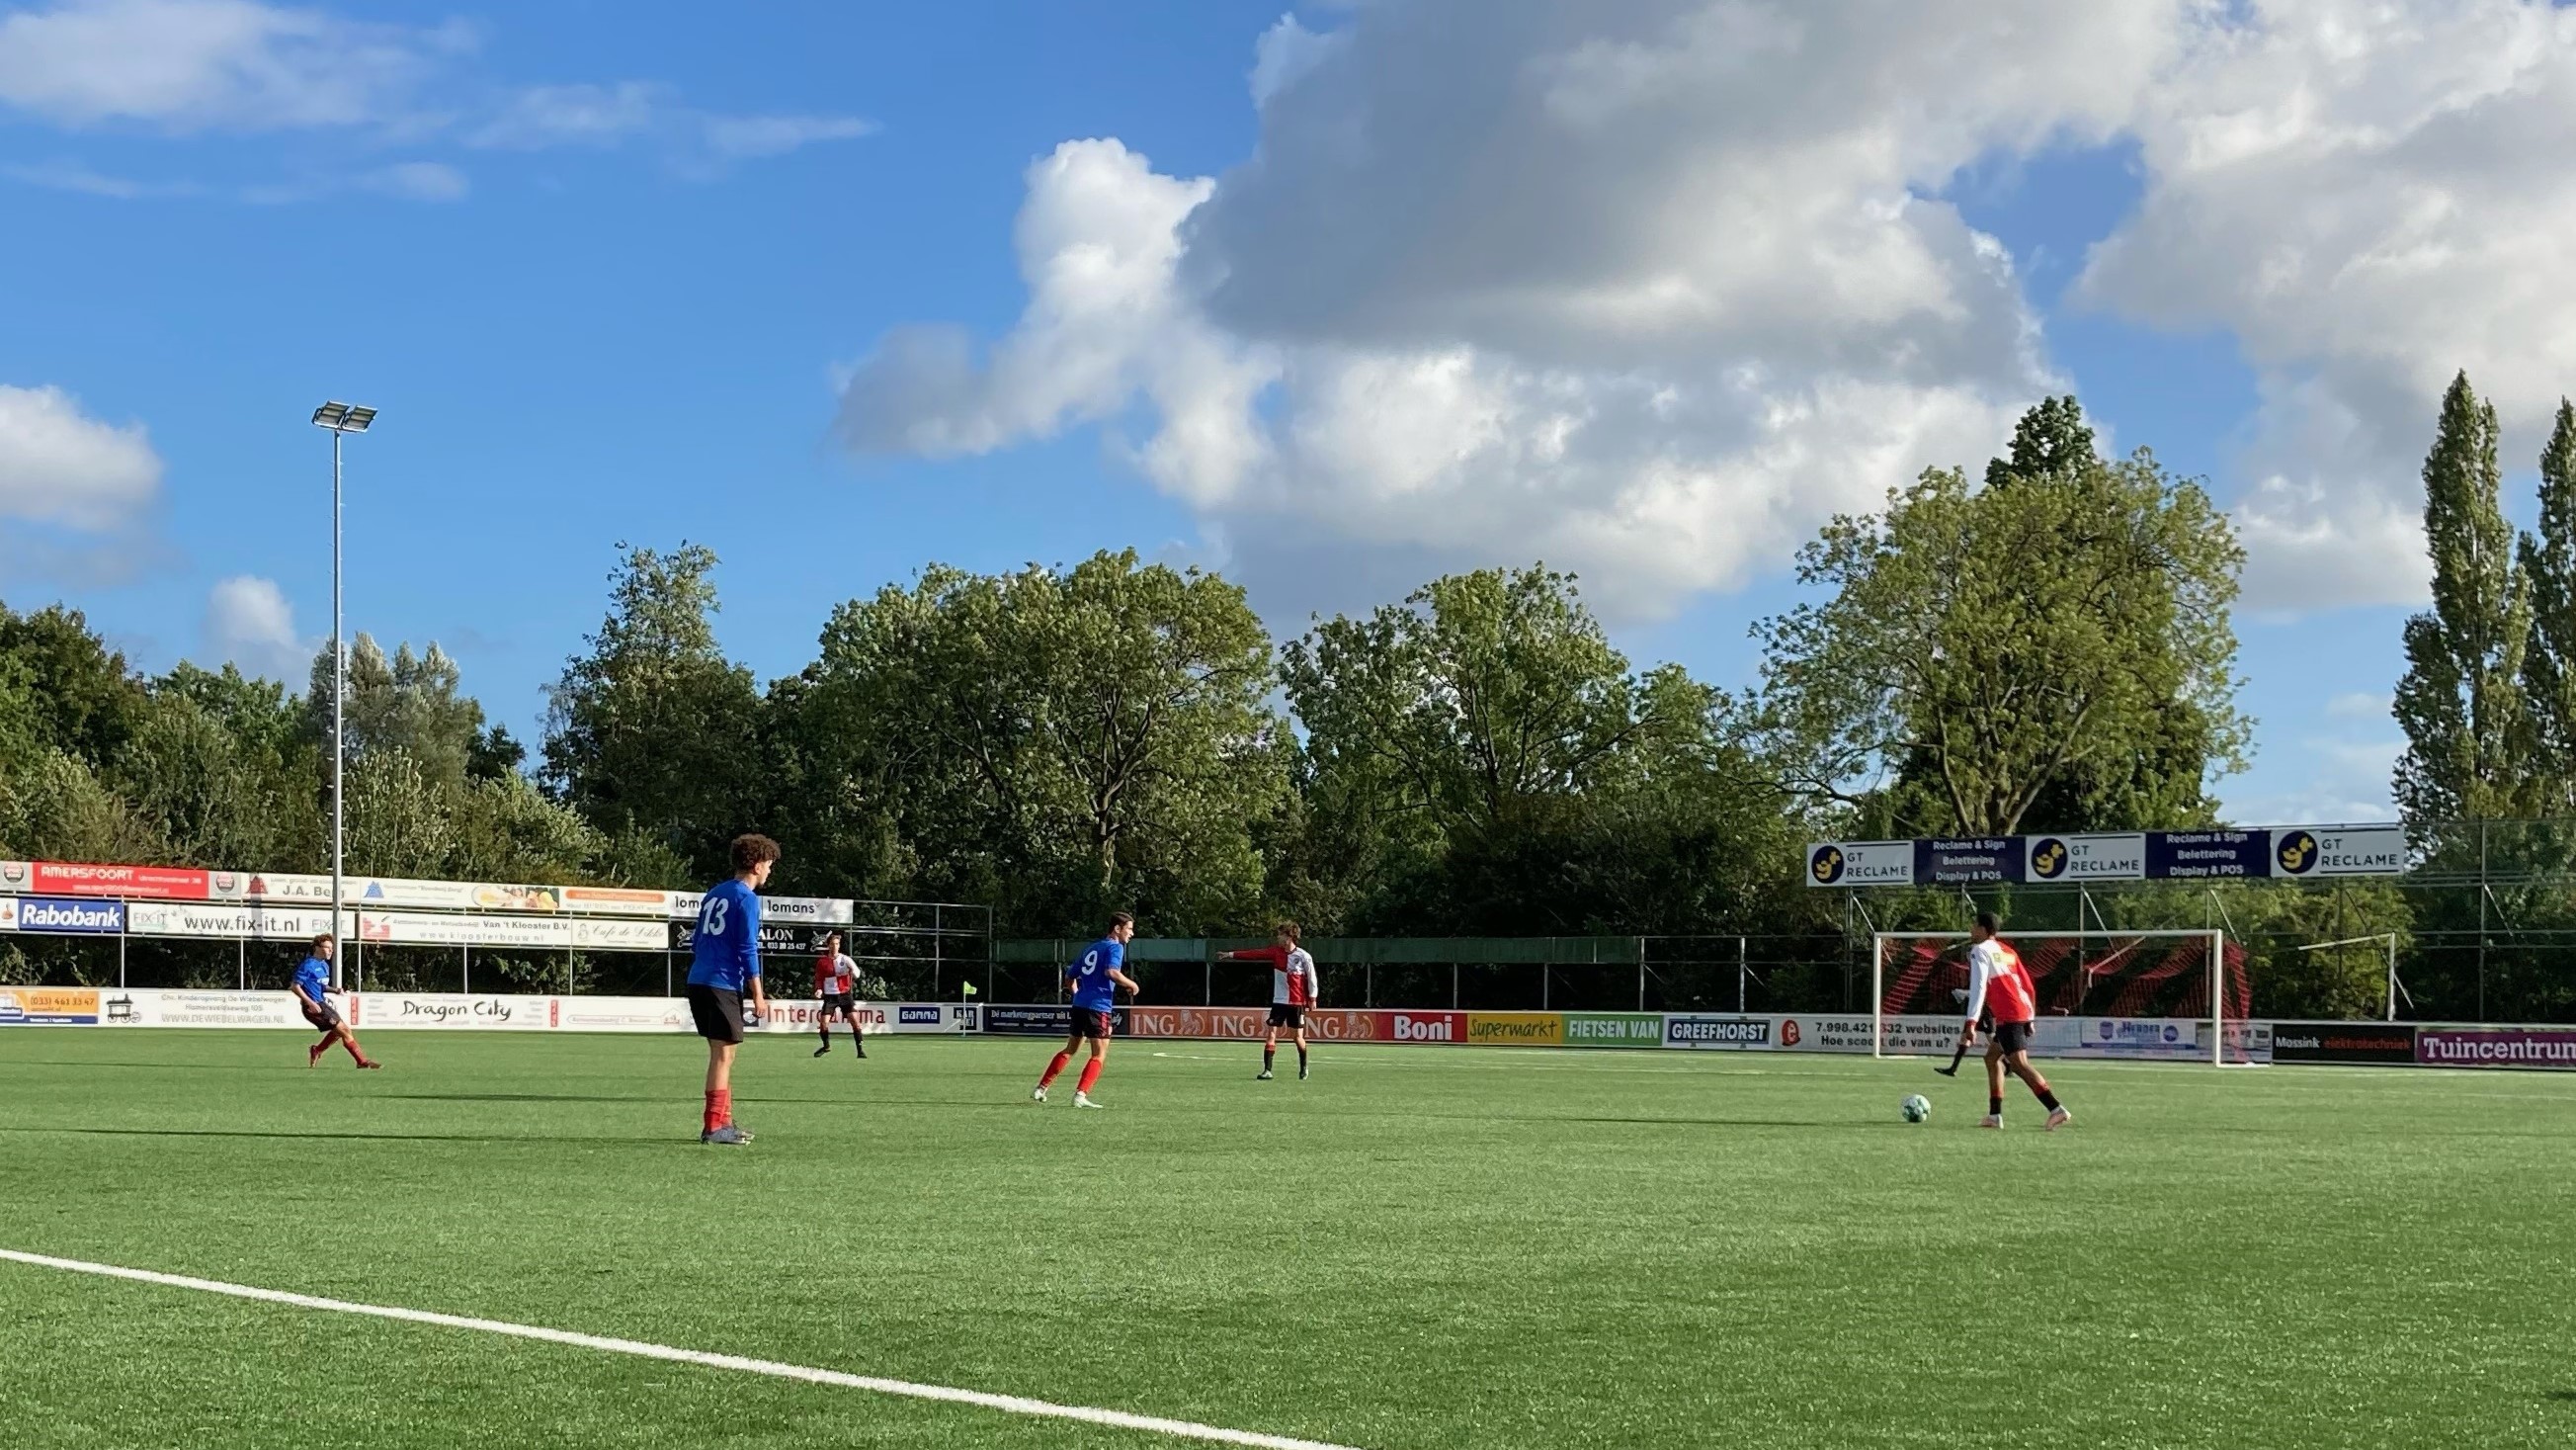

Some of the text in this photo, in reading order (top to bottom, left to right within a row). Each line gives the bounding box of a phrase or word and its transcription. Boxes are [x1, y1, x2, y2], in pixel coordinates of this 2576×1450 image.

[2167, 832, 2248, 844] Reclame & Sign
[2322, 838, 2343, 850] GT
[1933, 840, 2006, 852] Reclame & Sign
[2071, 845, 2090, 856] GT
[1847, 852, 1864, 863] GT
[1943, 855, 1995, 867] Belettering
[2177, 849, 2236, 860] Belettering
[2322, 854, 2398, 866] RECLAME
[1847, 866, 1908, 878] RECLAME
[2071, 860, 2140, 872] RECLAME
[2170, 865, 2208, 877] Display
[2220, 865, 2244, 875] POS
[41, 866, 134, 880] AMERSFOORT
[1936, 871, 1969, 883] Display
[1981, 871, 2002, 881] POS
[283, 886, 309, 896] J.A.
[674, 895, 702, 908] lom
[767, 899, 815, 914] lomans
[22, 903, 122, 927] Rabobank
[702, 896, 729, 936] 13
[184, 915, 300, 932] www.fix-it.nl
[483, 919, 501, 928] Van
[512, 920, 551, 930] Klooster
[758, 928, 794, 941] ALON
[1081, 950, 1098, 976] 9
[30, 995, 51, 1006] (033)
[400, 999, 468, 1022] Dragon
[474, 998, 512, 1022] City
[1134, 1014, 1176, 1035] ING
[1212, 1015, 1256, 1037] ING
[1305, 1016, 1341, 1038] NG
[1393, 1015, 1453, 1041] Boni
[1469, 1019, 1558, 1042] Supermarkt
[1569, 1019, 1660, 1039] FIETSEN VAN
[1672, 1023, 1767, 1041] GREEFHORST
[1821, 1035, 1952, 1049] Hoe scoot die van u?
